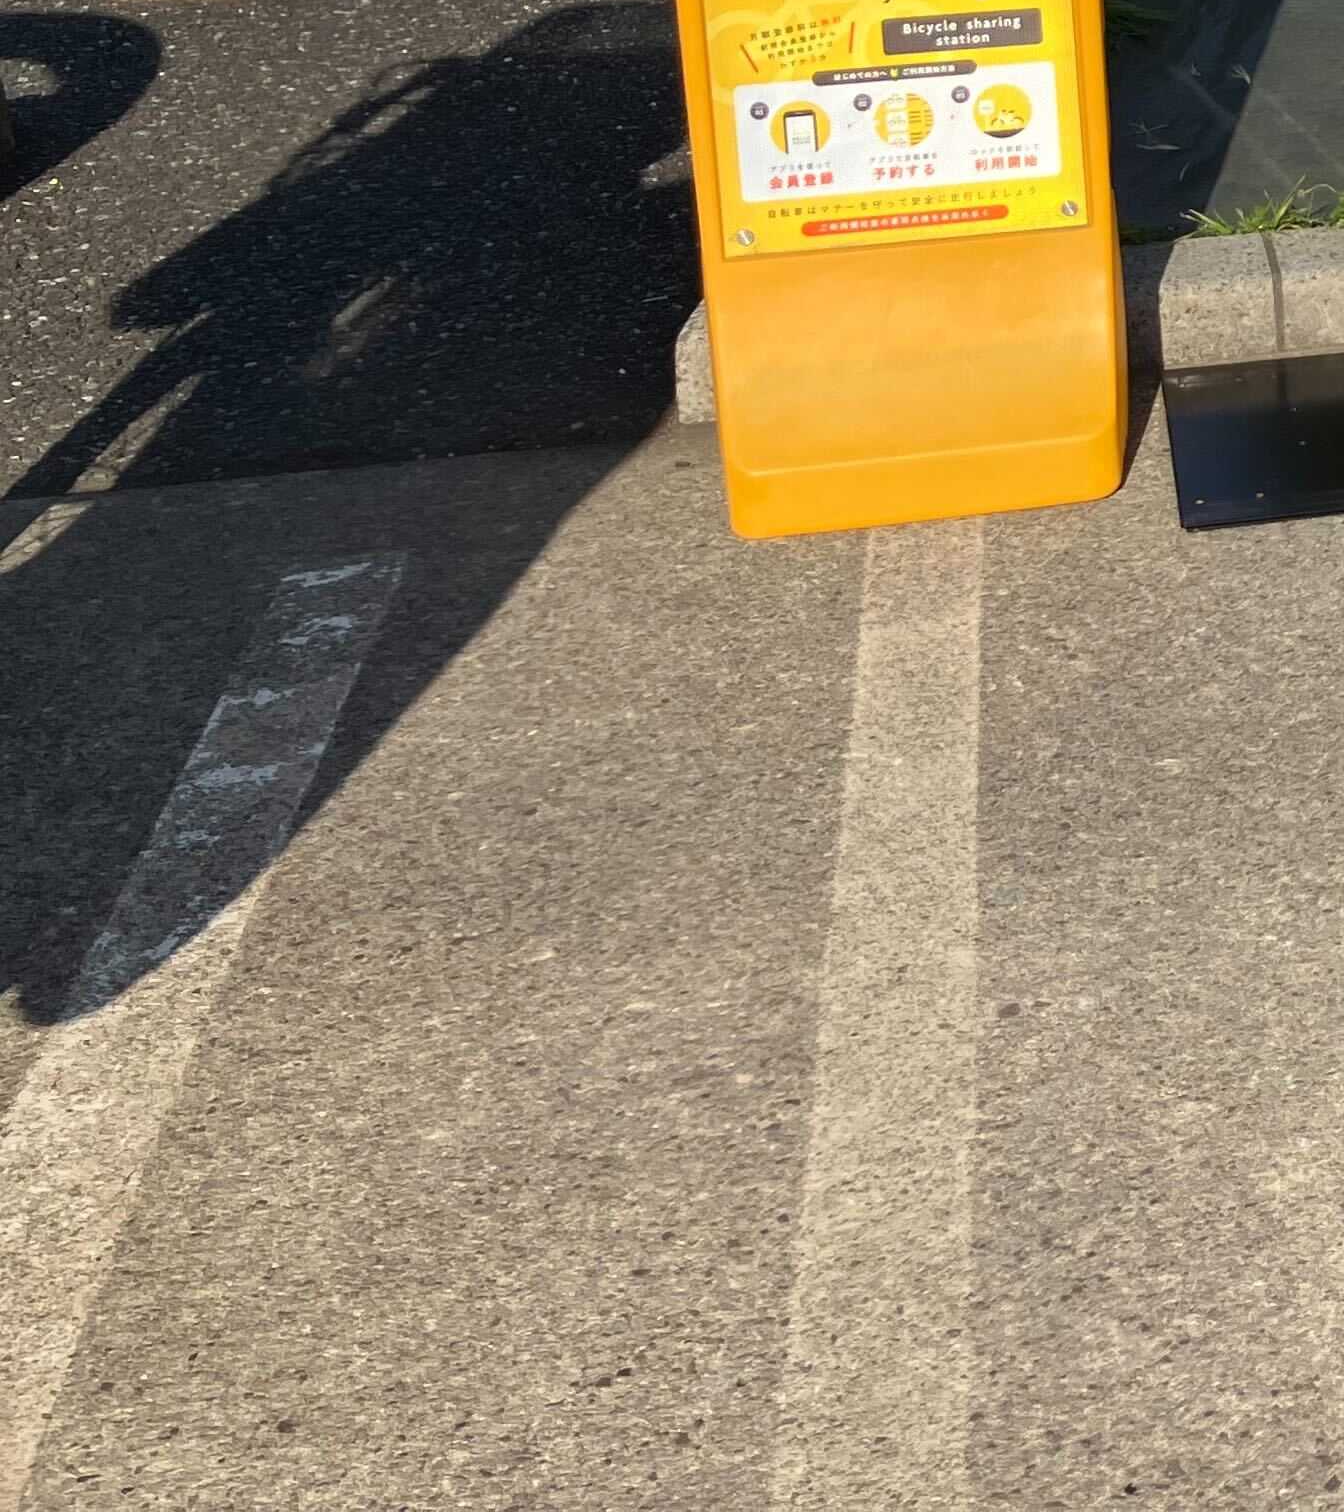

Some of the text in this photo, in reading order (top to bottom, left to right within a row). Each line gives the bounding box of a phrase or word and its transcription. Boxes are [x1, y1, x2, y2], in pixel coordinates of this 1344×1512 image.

[903, 15, 1022, 36] Bicycle sharing
[935, 33, 990, 47] station
[768, 172, 834, 190] 会員登録
[872, 163, 936, 181] 予約する
